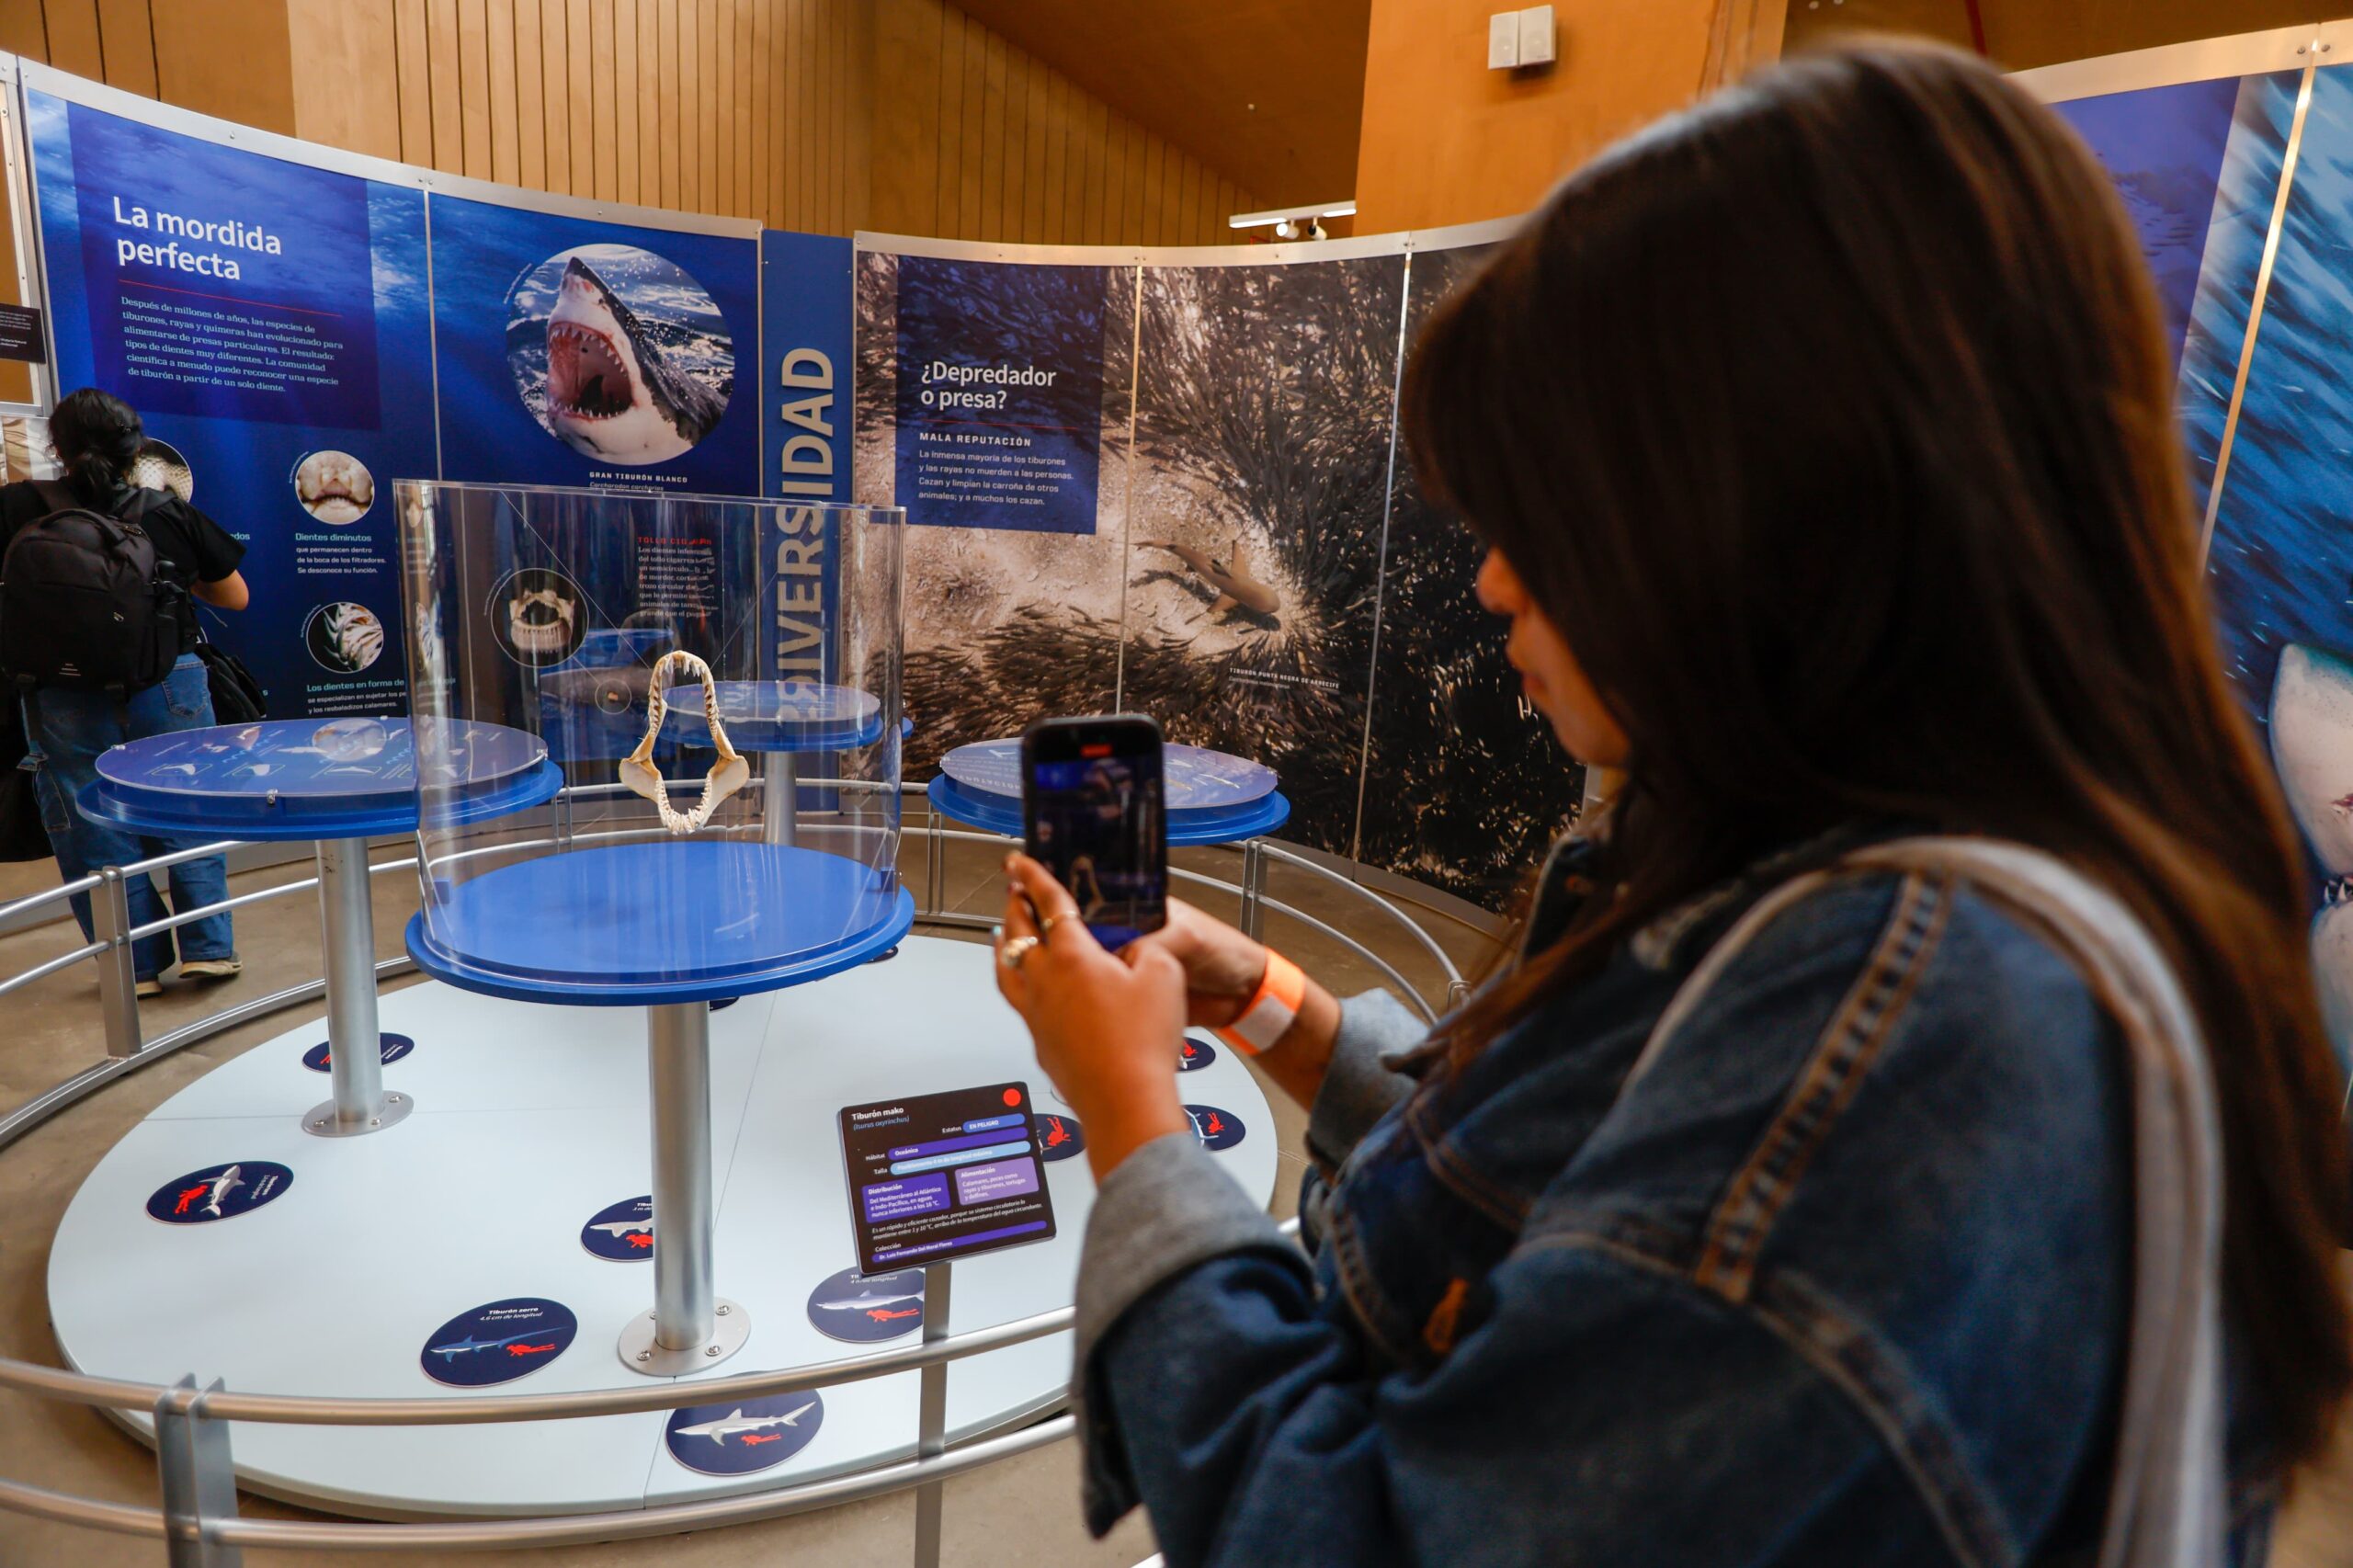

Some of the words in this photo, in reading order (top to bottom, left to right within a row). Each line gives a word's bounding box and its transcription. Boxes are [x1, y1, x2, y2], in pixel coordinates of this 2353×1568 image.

[113, 196, 149, 228] La
[156, 211, 281, 256] mordida
[117, 238, 241, 280] perfecta
[121, 296, 159, 311] Después
[161, 303, 172, 312] de
[175, 306, 211, 318] millones
[213, 312, 225, 321] de
[226, 313, 250, 324] años,
[251, 317, 264, 326] las
[266, 321, 302, 331] especies
[304, 324, 315, 333] de
[122, 312, 168, 325] tiburones,
[169, 320, 194, 329] rayas
[203, 324, 245, 335] quimeras
[246, 329, 264, 339] han
[265, 334, 322, 347] evolucionado
[323, 341, 343, 349] para
[123, 325, 177, 340] alimentarse
[179, 333, 190, 342] de
[192, 335, 222, 346] presas
[223, 340, 279, 353] particulares.
[281, 347, 290, 355] El
[292, 349, 335, 360] resultado:
[125, 339, 147, 349] tipos
[149, 342, 160, 350] de
[162, 344, 195, 355] dientes
[196, 351, 215, 359] muy
[217, 351, 264, 364] diferentes.
[265, 357, 276, 366] La
[278, 359, 326, 371] comunidad
[126, 354, 167, 366] científica
[176, 360, 212, 371] menudo
[214, 364, 241, 375] puede
[243, 368, 287, 380] reconocer
[306, 376, 339, 385] especie
[921, 360, 1057, 387] ¿Depredador
[141, 369, 174, 380] tiburón
[183, 374, 210, 383] partir
[210, 377, 222, 385] de
[237, 381, 255, 389] solo
[256, 382, 286, 392] diente.
[921, 390, 934, 404] o
[939, 390, 1007, 411] presa?
[919, 432, 952, 442] MALA
[957, 434, 1031, 447] REPUTACIÓN
[919, 449, 929, 458] La
[931, 450, 965, 460] inmensa
[968, 452, 1000, 463] mayoría
[1002, 453, 1012, 462] de
[1014, 455, 1026, 463] los
[1028, 456, 1066, 466] tiburones
[616, 472, 653, 482] TIBURÓN
[926, 464, 938, 472] las
[939, 466, 962, 475] rayas
[977, 467, 1012, 477] muerden
[1021, 469, 1033, 478] las
[1035, 471, 1074, 481] personas.
[919, 477, 944, 486] Cazan
[952, 478, 981, 489] limpian
[992, 482, 1023, 491] carroña
[1025, 483, 1035, 491] de
[1037, 483, 1059, 493] otros
[918, 491, 957, 501] animales;
[972, 494, 1004, 503] muchos
[1006, 495, 1017, 504] los
[1019, 497, 1045, 506] cazan.
[776, 347, 834, 687] IVERSIDAD
[295, 532, 328, 541] Dientes
[330, 533, 372, 542] diminutos
[306, 684, 323, 692] Los
[323, 682, 355, 691] dientes
[368, 679, 392, 687] forma
[316, 694, 355, 704] especializan
[365, 691, 387, 700] sujetar
[324, 703, 363, 712] resbaladizos
[851, 1109, 881, 1120] Tiburón
[882, 1107, 904, 1116] mako
[853, 1121, 874, 1131] (Isurus
[875, 1114, 910, 1127] oxyrinchus)
[977, 1119, 999, 1129] PELIGRO
[865, 1153, 885, 1161] Hábitat
[961, 1166, 995, 1178] Alimentación
[868, 1183, 903, 1195] Distribución
[874, 1243, 902, 1253] Colección
